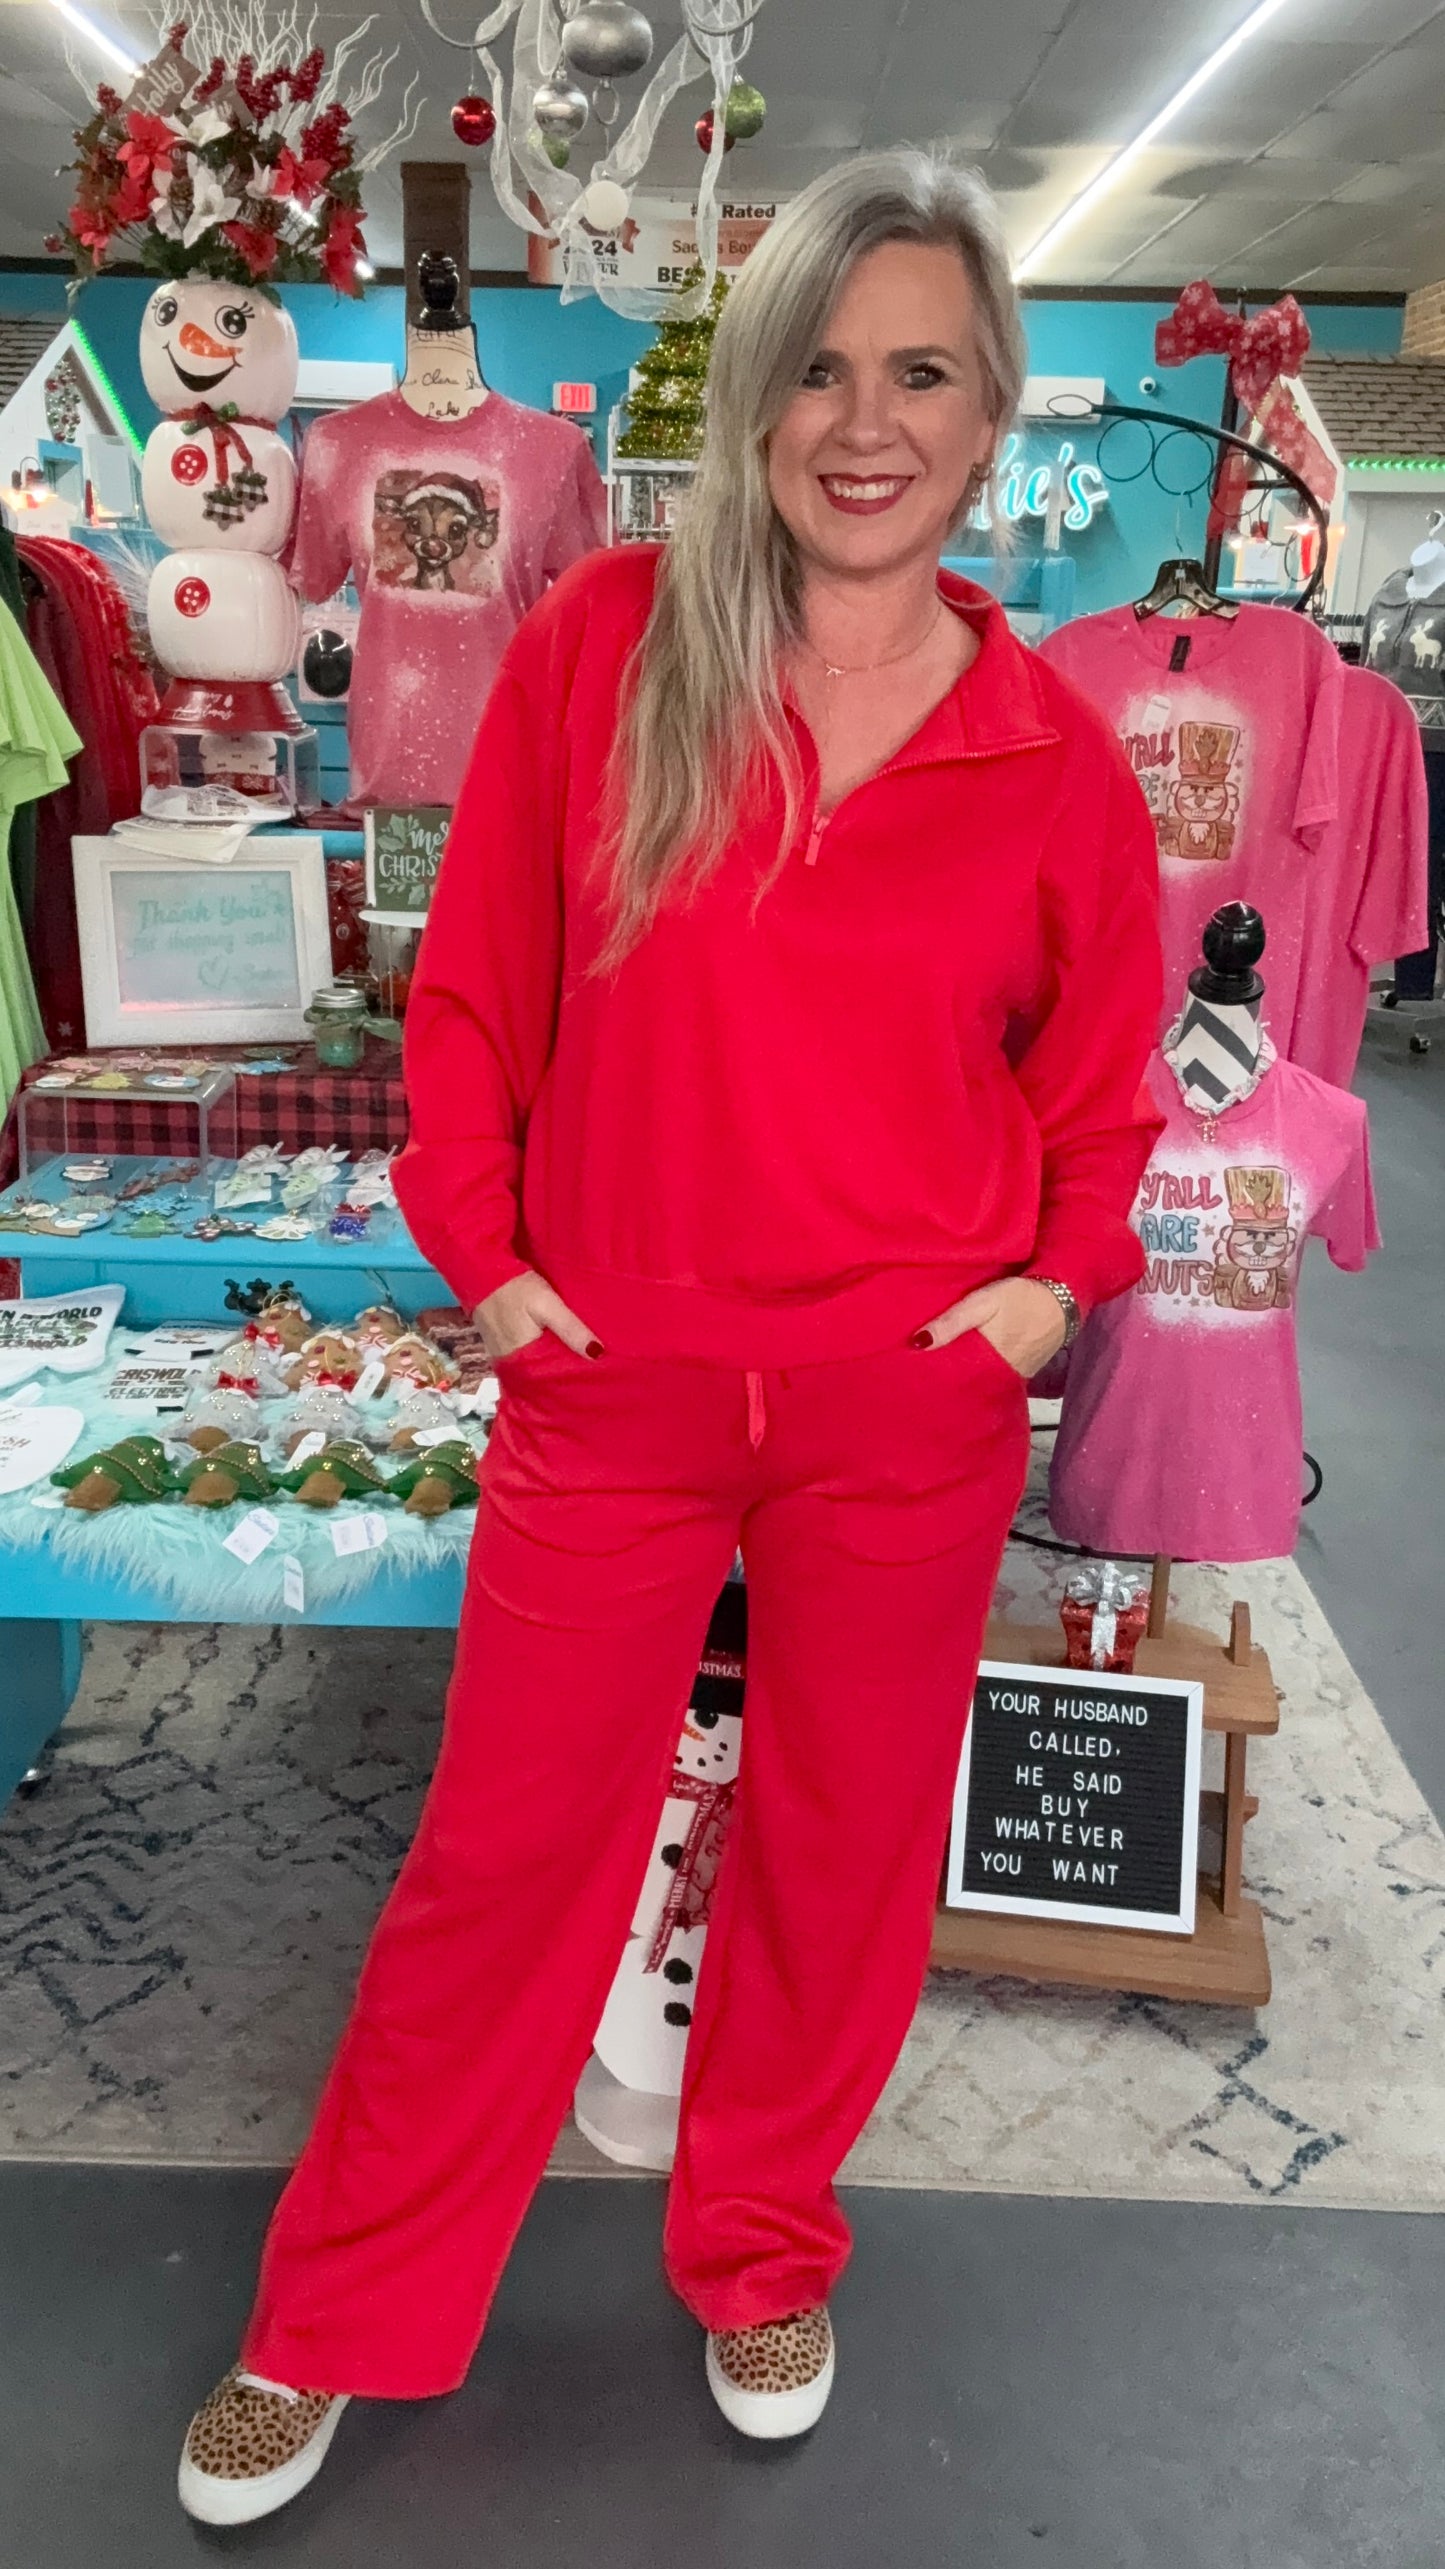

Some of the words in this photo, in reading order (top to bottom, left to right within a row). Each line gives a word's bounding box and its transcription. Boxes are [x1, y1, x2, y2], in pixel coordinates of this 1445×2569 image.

[721, 204, 776, 219] Rated
[560, 383, 590, 410] EXIT
[378, 851, 443, 878] CHRIS
[1140, 1170, 1223, 1211] Y'ALL
[1140, 1213, 1200, 1253] ARE
[1137, 1258, 1215, 1296] NUTS
[989, 1691, 1040, 1716] YOUR
[1054, 1698, 1148, 1726] HUSBAND
[1029, 1730, 1121, 1758] CALLED,
[1016, 1764, 1044, 1787] HE
[1073, 1771, 1122, 1795] SAID
[1041, 1794, 1088, 1818] BUY
[995, 1816, 1124, 1850] WHATEVER
[980, 1851, 1022, 1875] YOU
[1052, 1859, 1119, 1886] WANT
